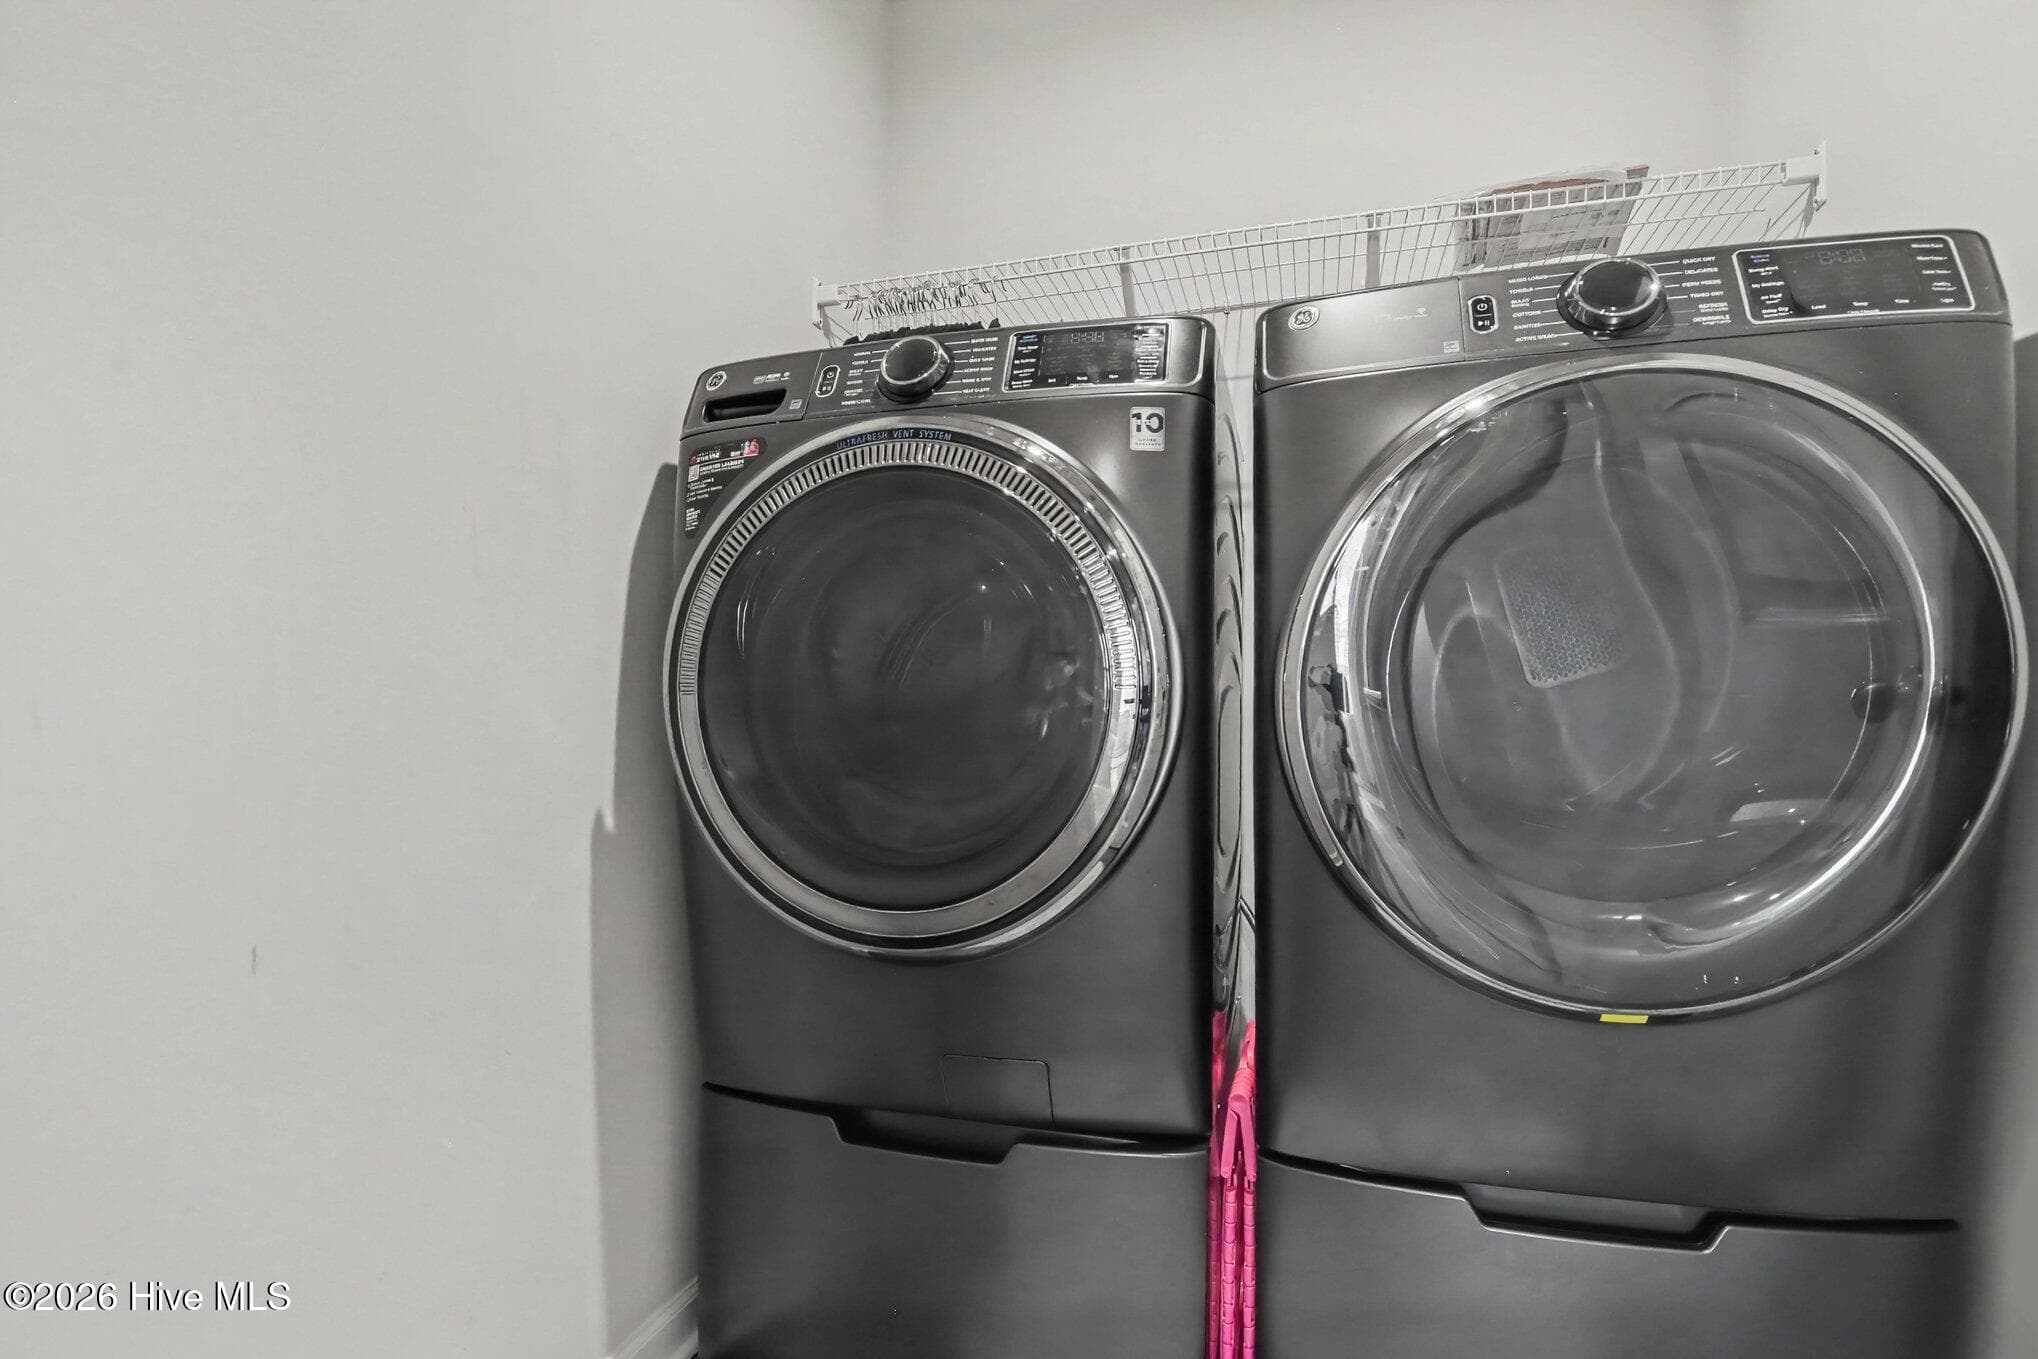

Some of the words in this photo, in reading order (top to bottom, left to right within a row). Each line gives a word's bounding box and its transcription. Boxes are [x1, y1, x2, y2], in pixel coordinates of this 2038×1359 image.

[1131, 412, 1164, 434] 10
[836, 431, 889, 450] ULTRAFRESH
[892, 429, 915, 438] VENT
[919, 429, 952, 441] SYSTEM
